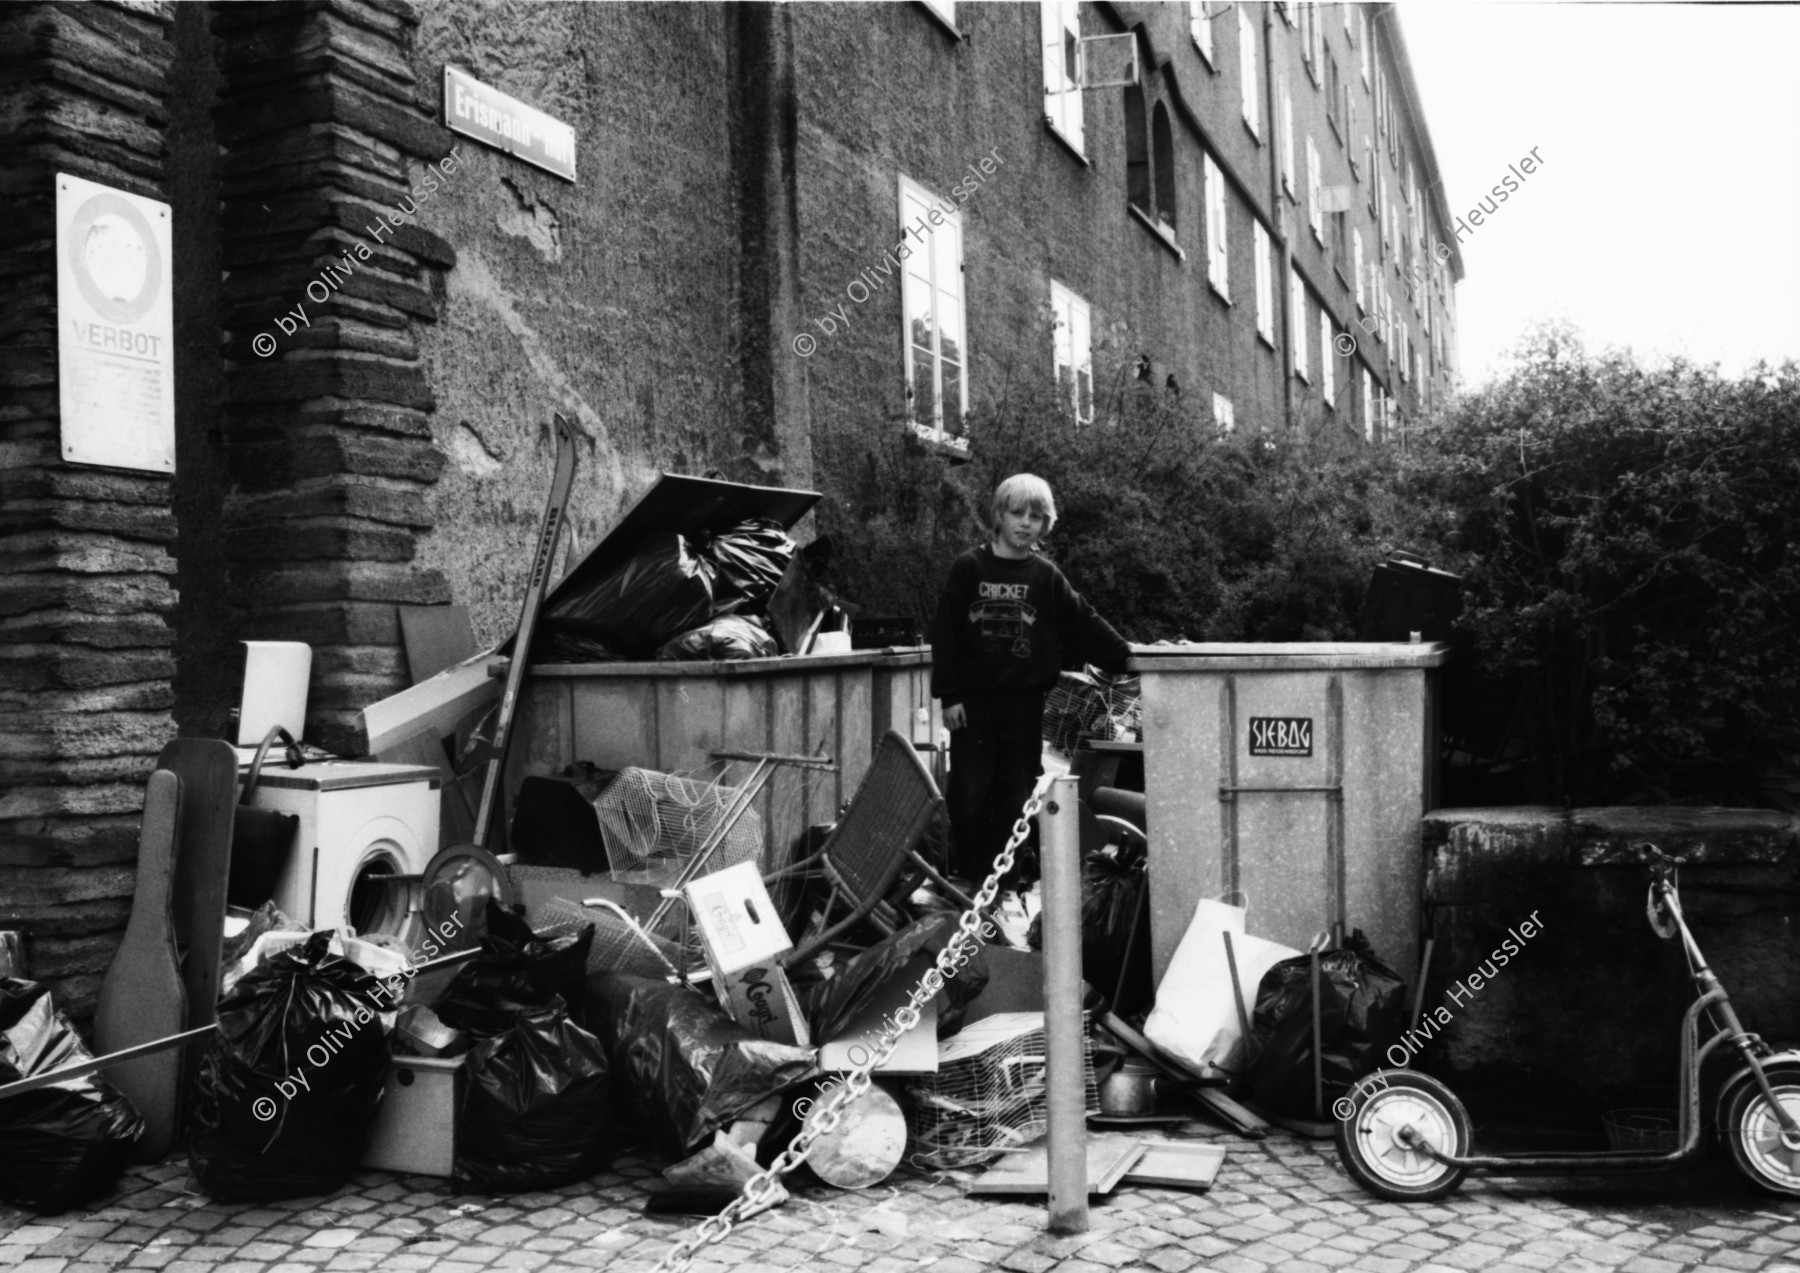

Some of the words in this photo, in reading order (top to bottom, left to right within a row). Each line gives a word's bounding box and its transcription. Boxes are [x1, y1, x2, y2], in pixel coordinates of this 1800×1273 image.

[73, 320, 161, 357] VERBOT
[533, 507, 559, 588] BLIZZARD
[979, 581, 1030, 600] CRICKET
[1252, 720, 1310, 748] SIEBAG
